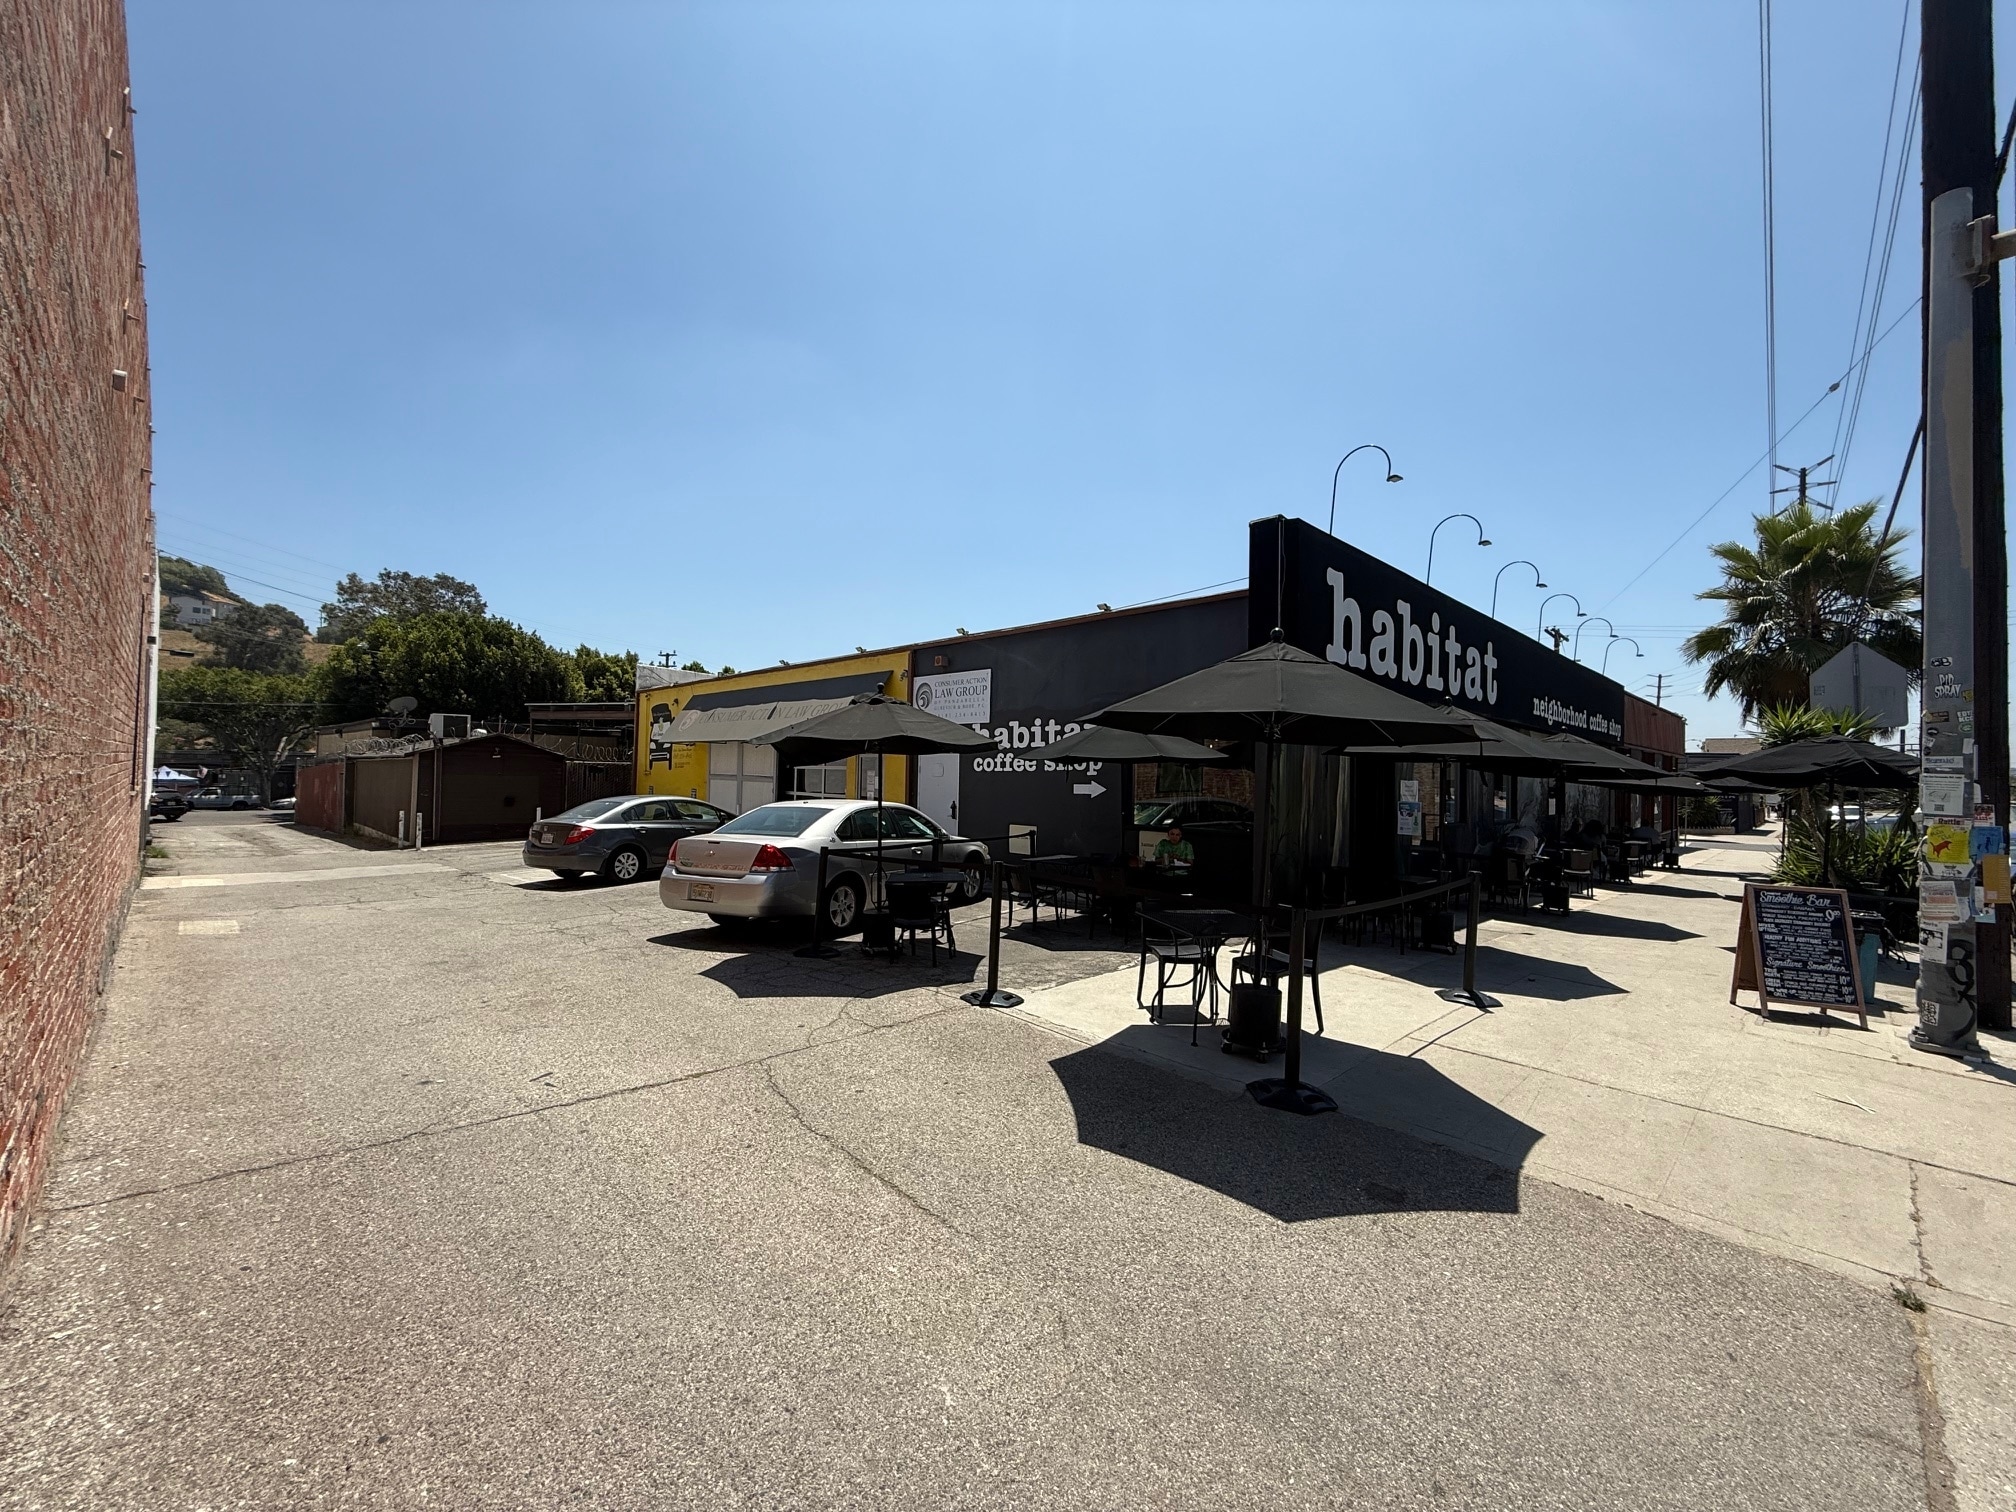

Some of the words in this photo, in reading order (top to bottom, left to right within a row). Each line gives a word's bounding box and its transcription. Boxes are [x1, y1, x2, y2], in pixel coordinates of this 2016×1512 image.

[1326, 566, 1498, 705] habitat
[934, 679, 965, 688] CONSUMER
[966, 677, 987, 685] ACTION
[934, 688, 955, 699] LAW
[955, 685, 988, 698] GROUP
[1934, 684, 1962, 699] SPRAY
[785, 704, 810, 719] LAW
[1533, 696, 1588, 728] neighborhood
[1589, 713, 1608, 733] coffee
[1609, 719, 1621, 741] shop
[973, 753, 1037, 772] coffee
[1760, 891, 1804, 904] Smoothie
[1806, 894, 1831, 907] Bar
